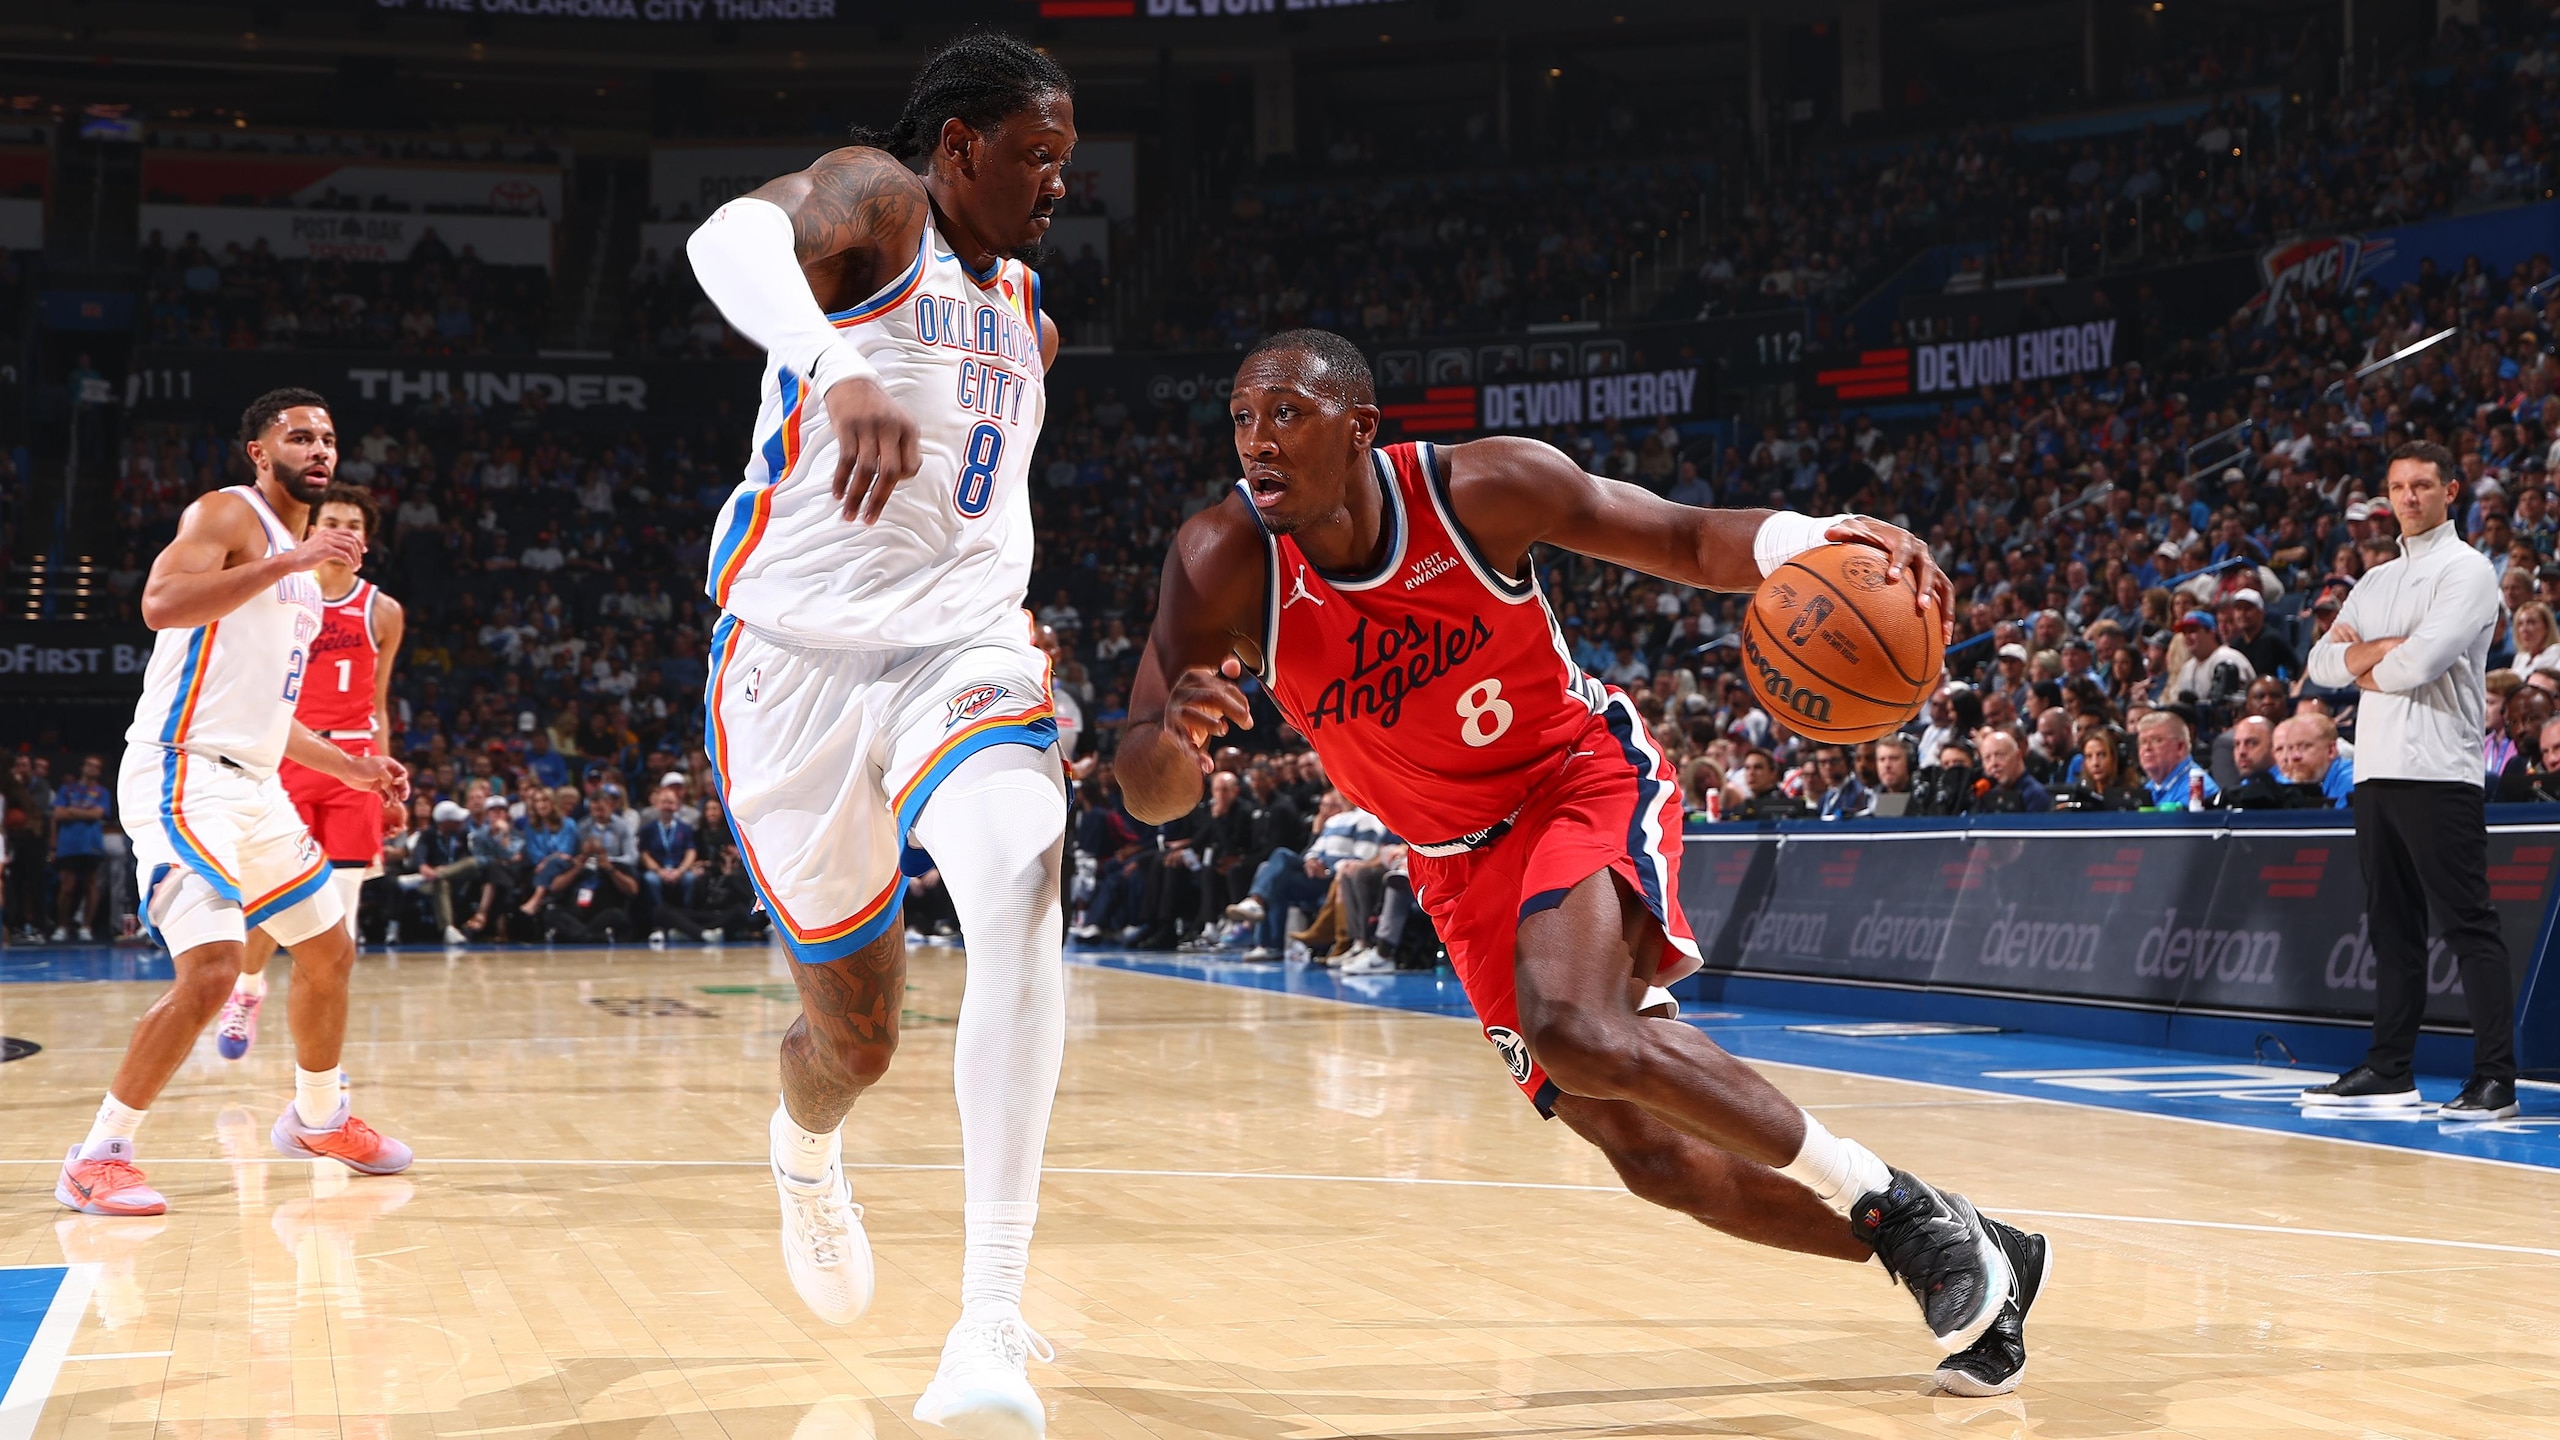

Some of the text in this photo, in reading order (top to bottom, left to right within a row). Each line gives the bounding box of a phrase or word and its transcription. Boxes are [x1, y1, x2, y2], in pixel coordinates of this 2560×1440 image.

[644, 0, 704, 21] CITY
[715, 0, 835, 19] THUNDER
[292, 217, 403, 243] POST OAK
[1756, 331, 1802, 365] 112
[1917, 319, 2117, 393] DEVON ENERGY
[144, 369, 191, 399] 111
[348, 369, 647, 411] THUNDER
[957, 357, 1026, 426] CITY
[1484, 368, 1697, 429] DEVON ENERGY
[953, 420, 1005, 519] 8
[1404, 556, 1459, 591] RWANDA
[1411, 552, 1442, 574] VISIT
[280, 646, 303, 706] 2
[335, 659, 351, 692] 1
[1307, 613, 1494, 729] Angeles
[1346, 613, 1429, 681] Los
[945, 688, 994, 728] OKC
[1455, 678, 1514, 747] 8
[1738, 896, 1828, 951] devon
[1851, 900, 1951, 961] devon
[1979, 902, 2101, 972] devon
[2135, 907, 2282, 984] devon
